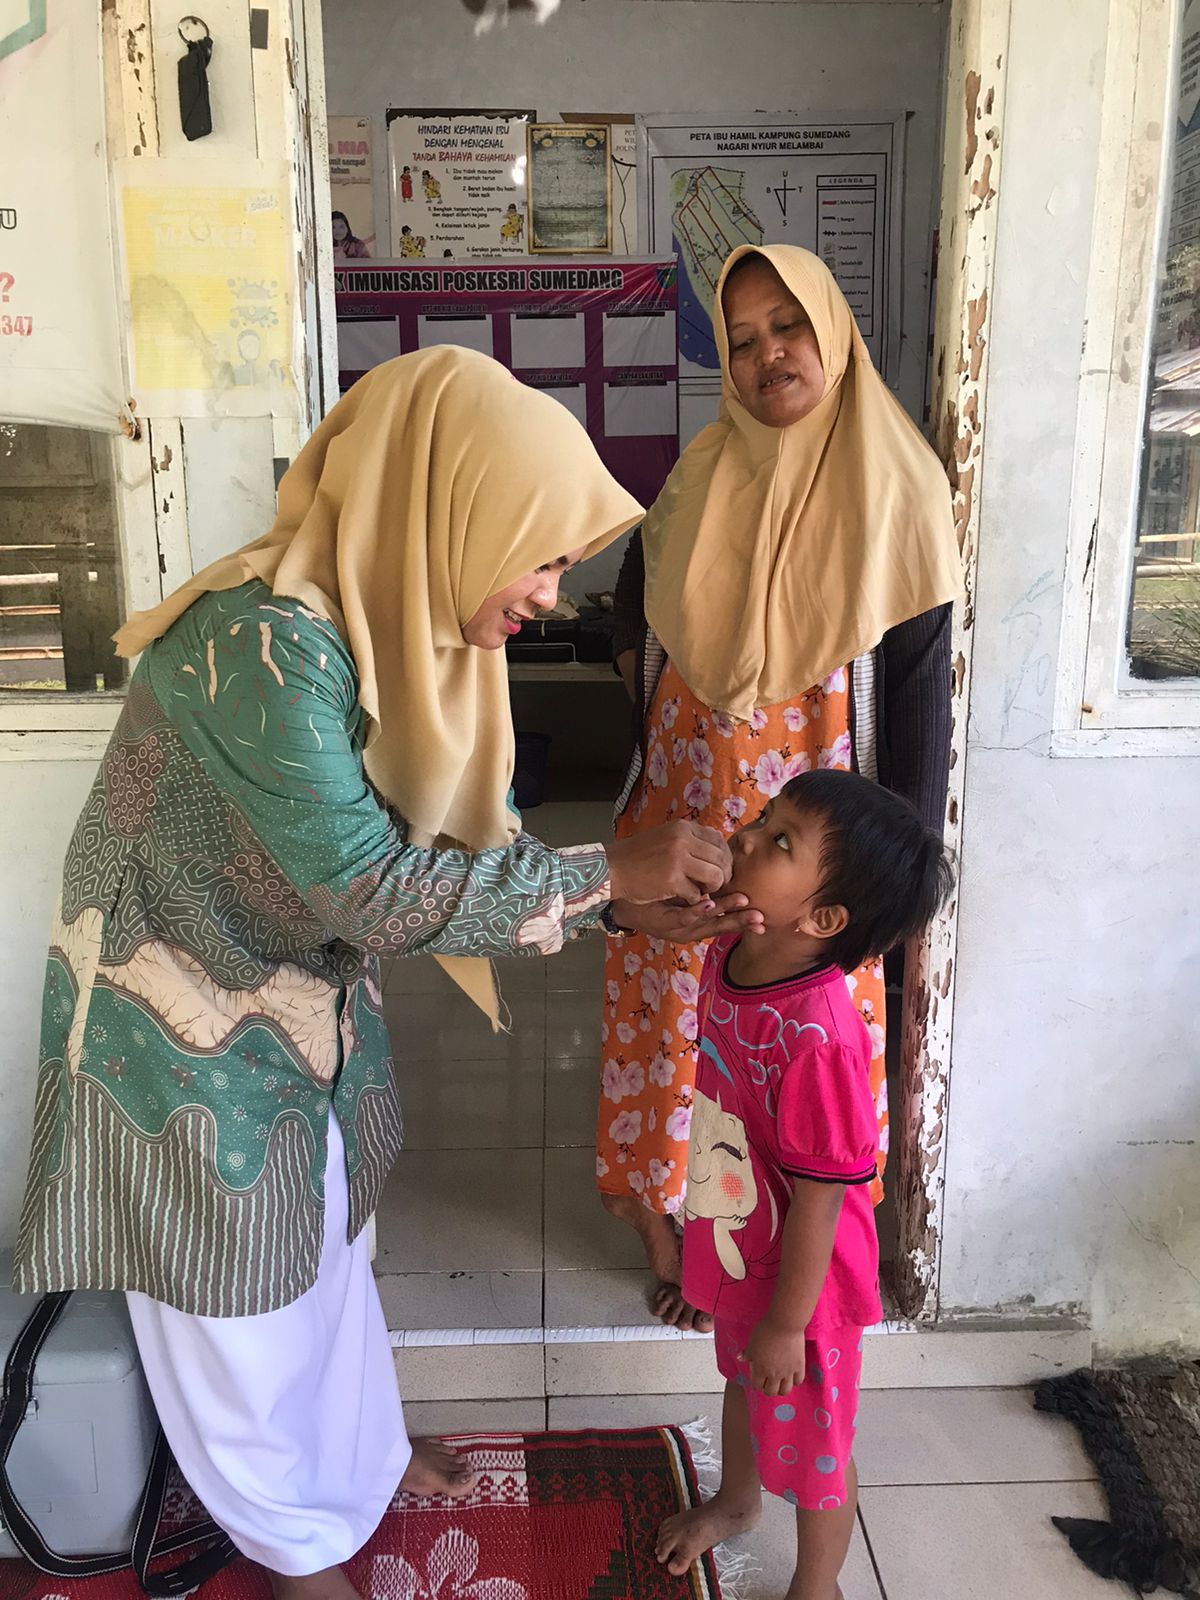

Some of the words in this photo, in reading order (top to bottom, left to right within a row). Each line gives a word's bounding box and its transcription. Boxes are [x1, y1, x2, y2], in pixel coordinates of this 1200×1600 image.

[417, 125, 451, 135] HINDARI
[453, 125, 493, 135] KEMATIAN
[495, 125, 510, 135] IBU
[690, 133, 711, 141] PETA
[713, 132, 728, 141] IBU
[729, 132, 757, 140] HAMIL
[758, 131, 800, 140] KAMPUNG
[802, 130, 851, 139] SUMEDANG
[424, 138, 458, 148] DENGAN
[460, 138, 504, 149] MENGENAL
[717, 142, 749, 151] NAGARI
[751, 142, 777, 151] NYIUR
[779, 141, 824, 150] MELAMBAI
[412, 152, 436, 162] TANDA
[438, 151, 472, 162] BAHAYA
[475, 153, 517, 162] KEHAMILAN
[766, 186, 772, 194] B
[782, 219, 788, 227] S
[347, 270, 440, 293] IMUNISASI
[442, 270, 526, 292] POSKESRI
[529, 269, 623, 291] SUMEDANG
[0, 271, 15, 303] ?
[0, 315, 33, 337] 347
